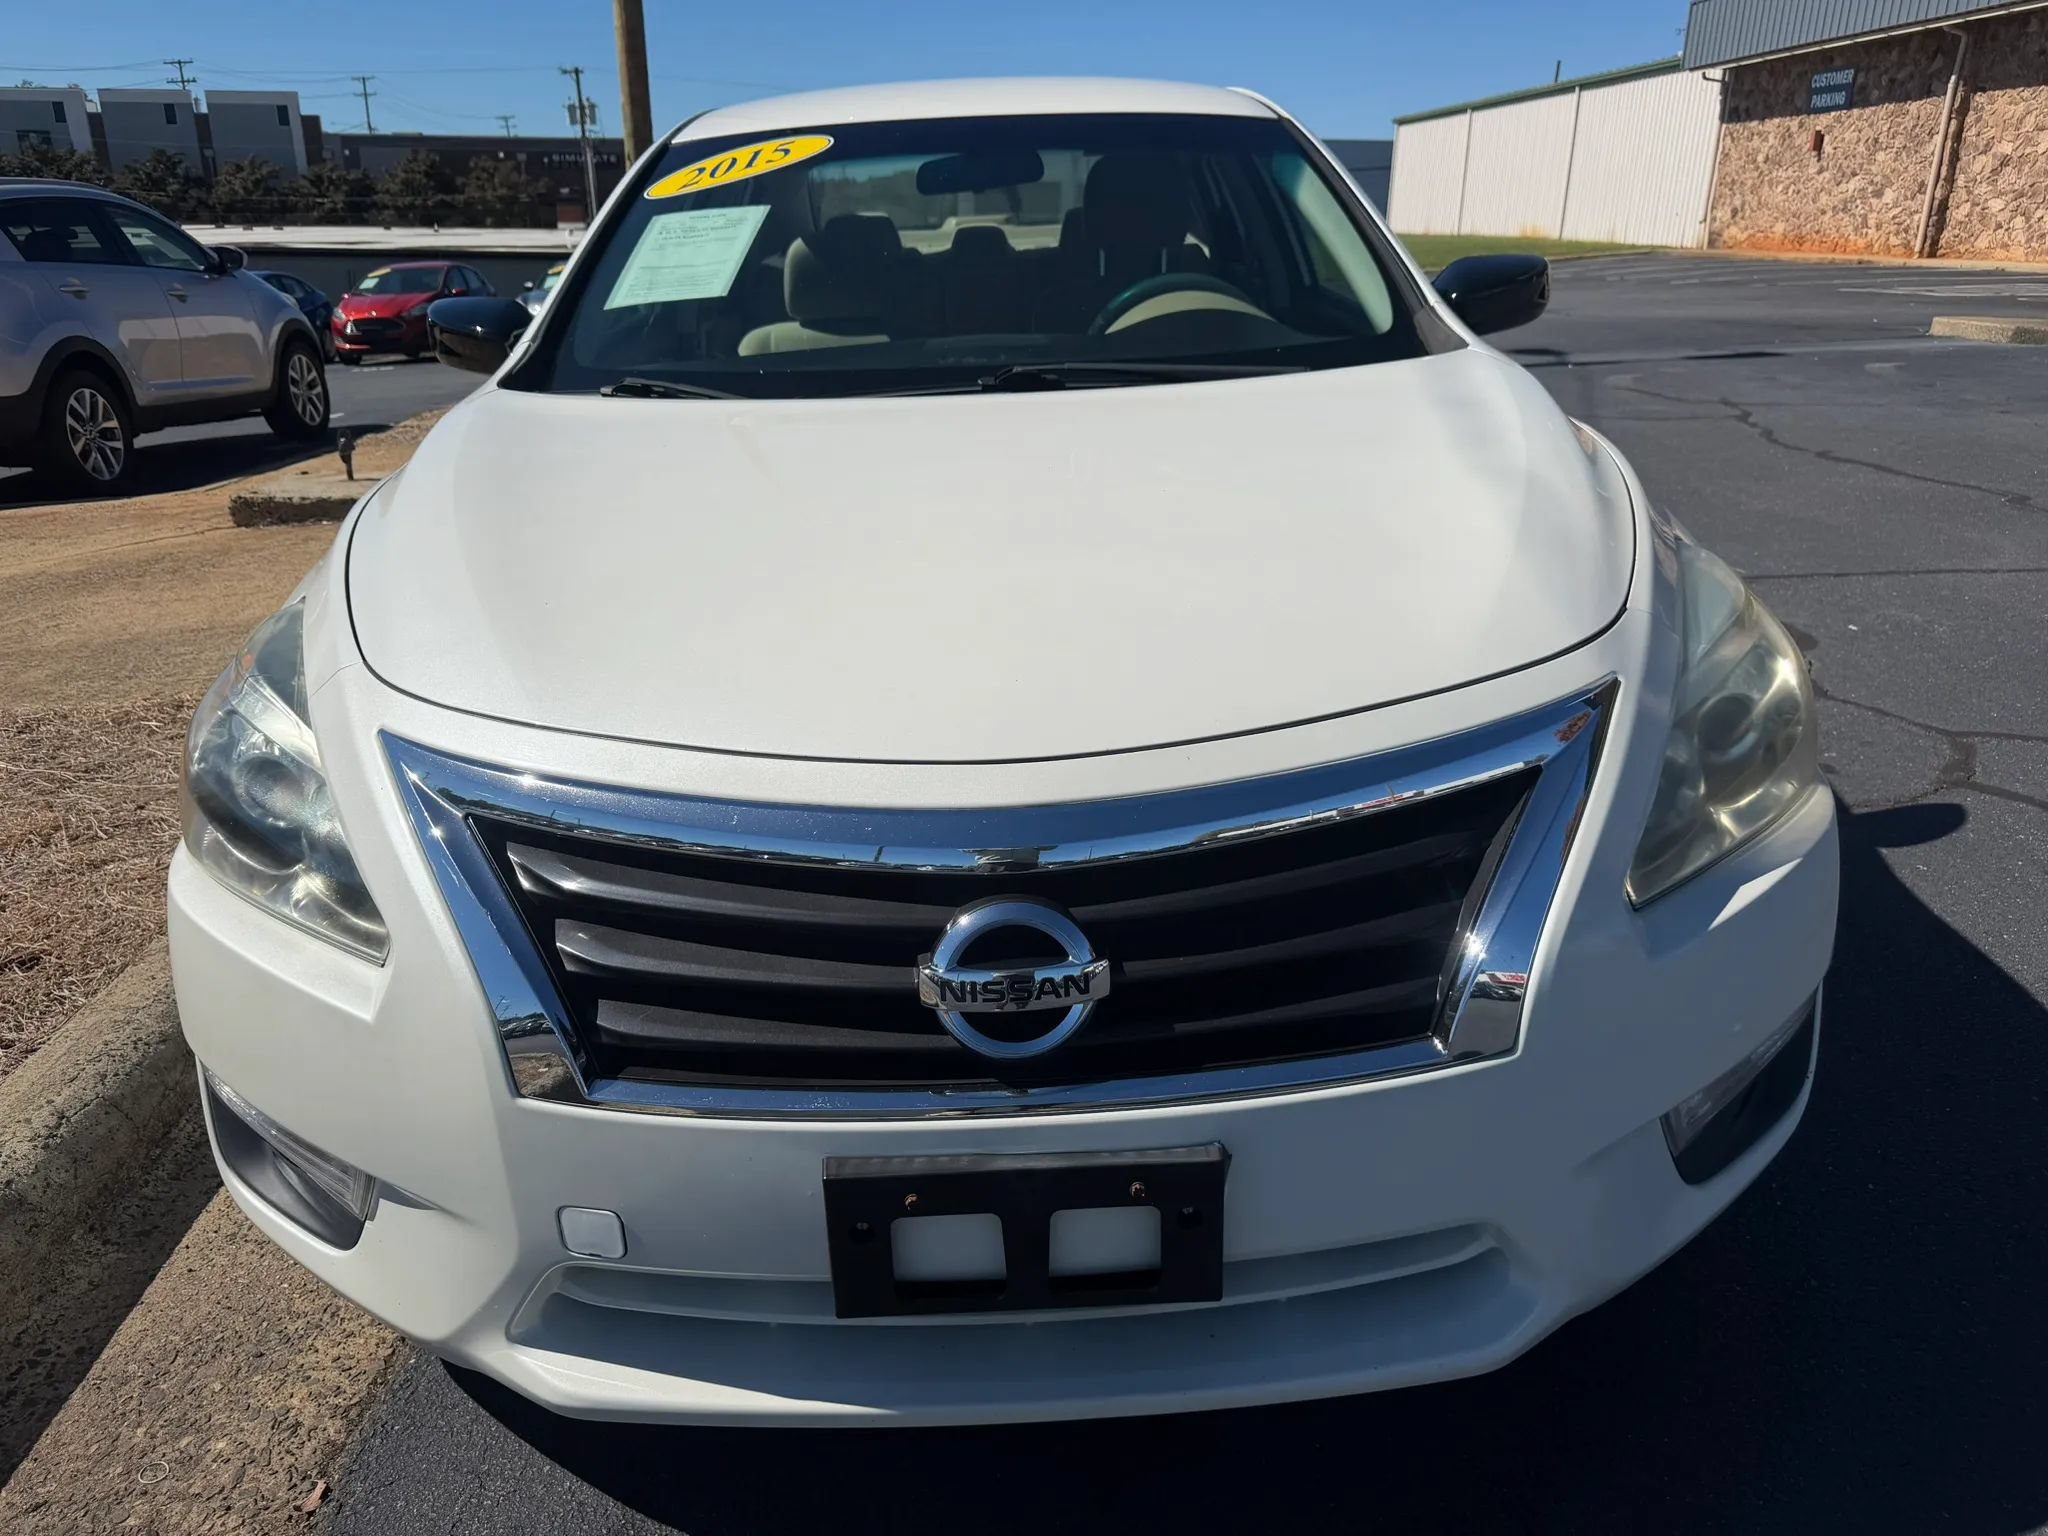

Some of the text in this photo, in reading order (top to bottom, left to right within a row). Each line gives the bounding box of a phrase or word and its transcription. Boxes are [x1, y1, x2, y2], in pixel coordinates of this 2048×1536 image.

[1811, 69, 1855, 88] CUSTOMER
[1810, 91, 1846, 108] PARKING
[676, 141, 796, 191] 2015
[939, 973, 1090, 1003] NISSAN
